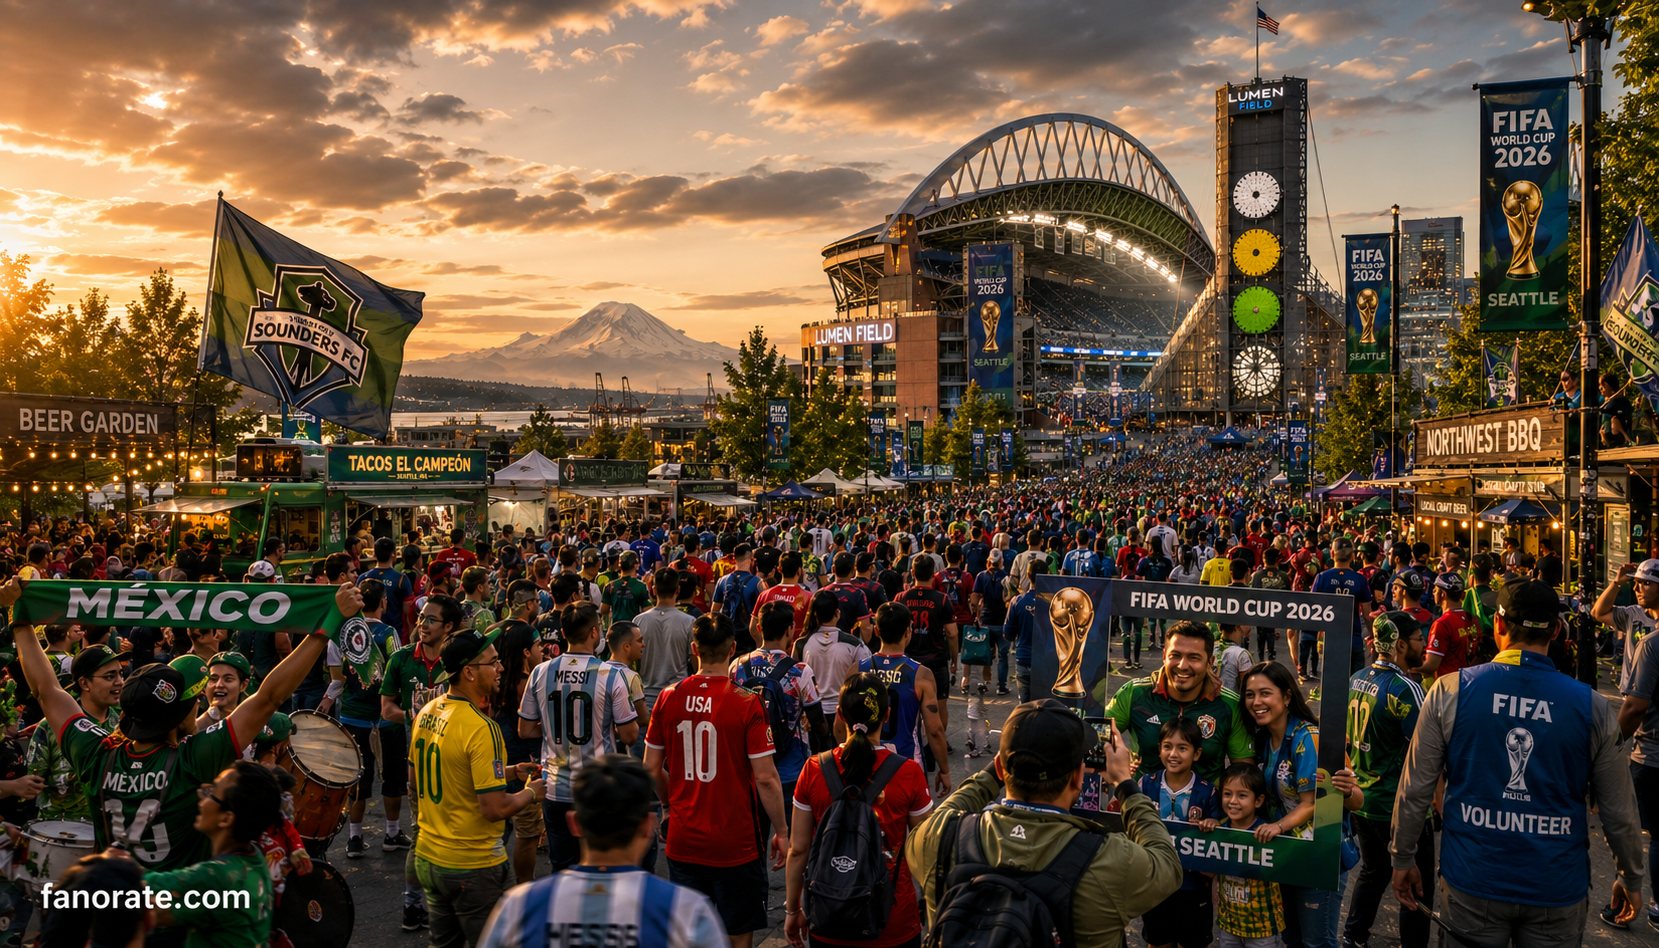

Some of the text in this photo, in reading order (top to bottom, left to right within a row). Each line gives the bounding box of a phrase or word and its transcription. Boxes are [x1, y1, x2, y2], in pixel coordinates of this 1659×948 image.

[1228, 86, 1284, 103] LUMEN
[1238, 99, 1273, 111] FIELD
[1492, 108, 1554, 134] FIFA
[1490, 132, 1556, 147] WORLD CUP
[1494, 145, 1552, 169] 2026
[1352, 248, 1385, 263] FIFA
[975, 264, 1006, 278] FIFA
[1352, 269, 1384, 282] 2026
[977, 284, 1005, 296] 2026
[1487, 291, 1559, 307] SEATTLE
[815, 322, 894, 346] LUMEN FIELD
[253, 322, 341, 356] SOUNDERS
[341, 347, 361, 371] FC
[1349, 351, 1387, 361] SEATTLE
[973, 357, 1009, 367] SEATTLE
[19, 407, 159, 435] BEER GARDEN
[1426, 416, 1542, 457] NORTHWEST BBQ
[348, 453, 472, 473] TACOS EL CAMPEÓN
[66, 582, 292, 625] MÉXICO
[1130, 591, 1336, 623] FIFA WORLD CUP 2026
[553, 670, 591, 685] MESSI
[685, 695, 713, 714] USA
[1492, 692, 1553, 723] FIFA
[548, 690, 593, 746] 10
[677, 719, 718, 783] 10
[415, 737, 443, 805] 10
[1460, 802, 1572, 835] VOLUNTEER
[1179, 836, 1275, 868] SEATTLE
